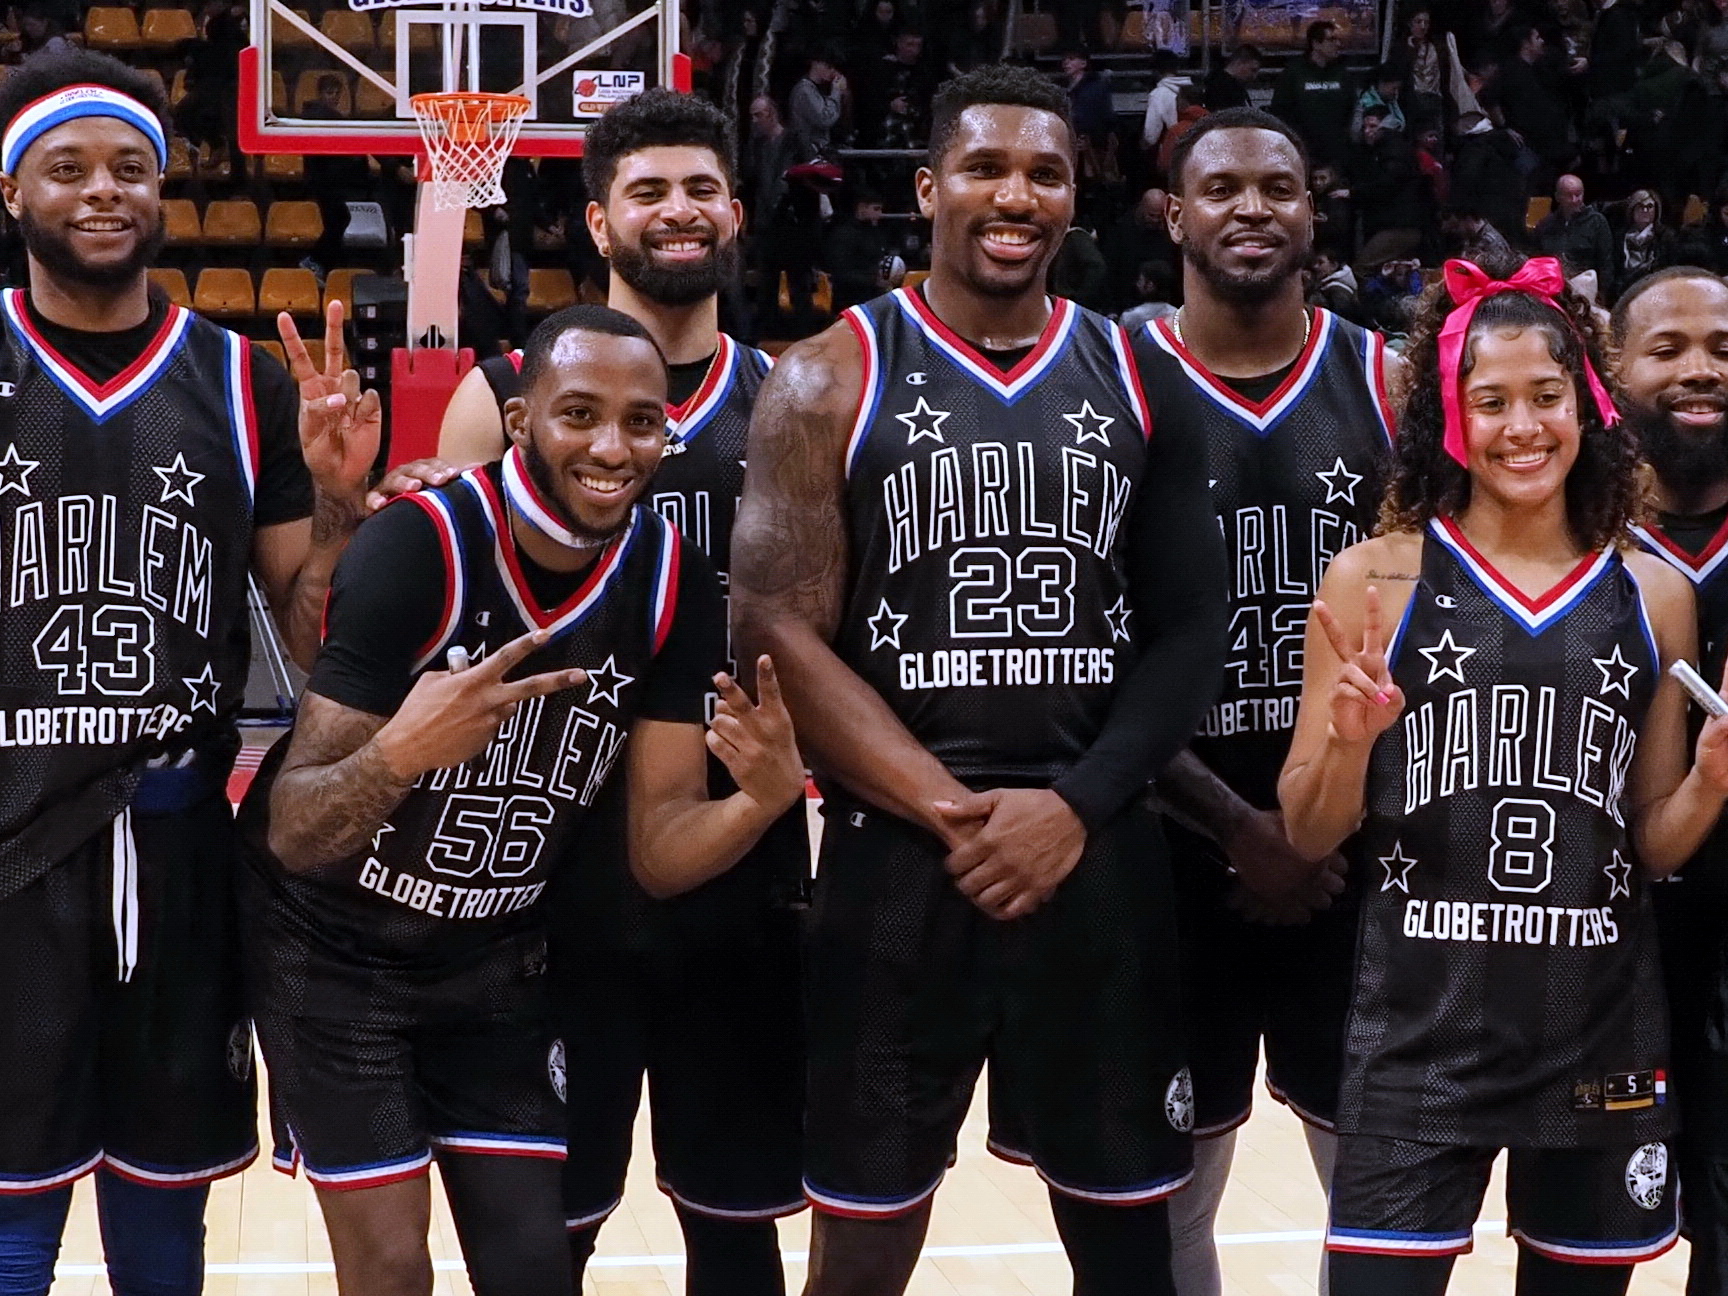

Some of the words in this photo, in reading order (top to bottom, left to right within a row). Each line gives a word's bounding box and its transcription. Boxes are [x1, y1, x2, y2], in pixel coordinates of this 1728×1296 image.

[598, 74, 640, 88] LNP
[949, 546, 1077, 639] 23
[32, 603, 156, 697] 43
[898, 646, 1116, 691] GLOBETROTTERS
[426, 793, 555, 879] 56
[1487, 797, 1556, 894] 8
[1402, 899, 1619, 947] GLOBETROTTERS
